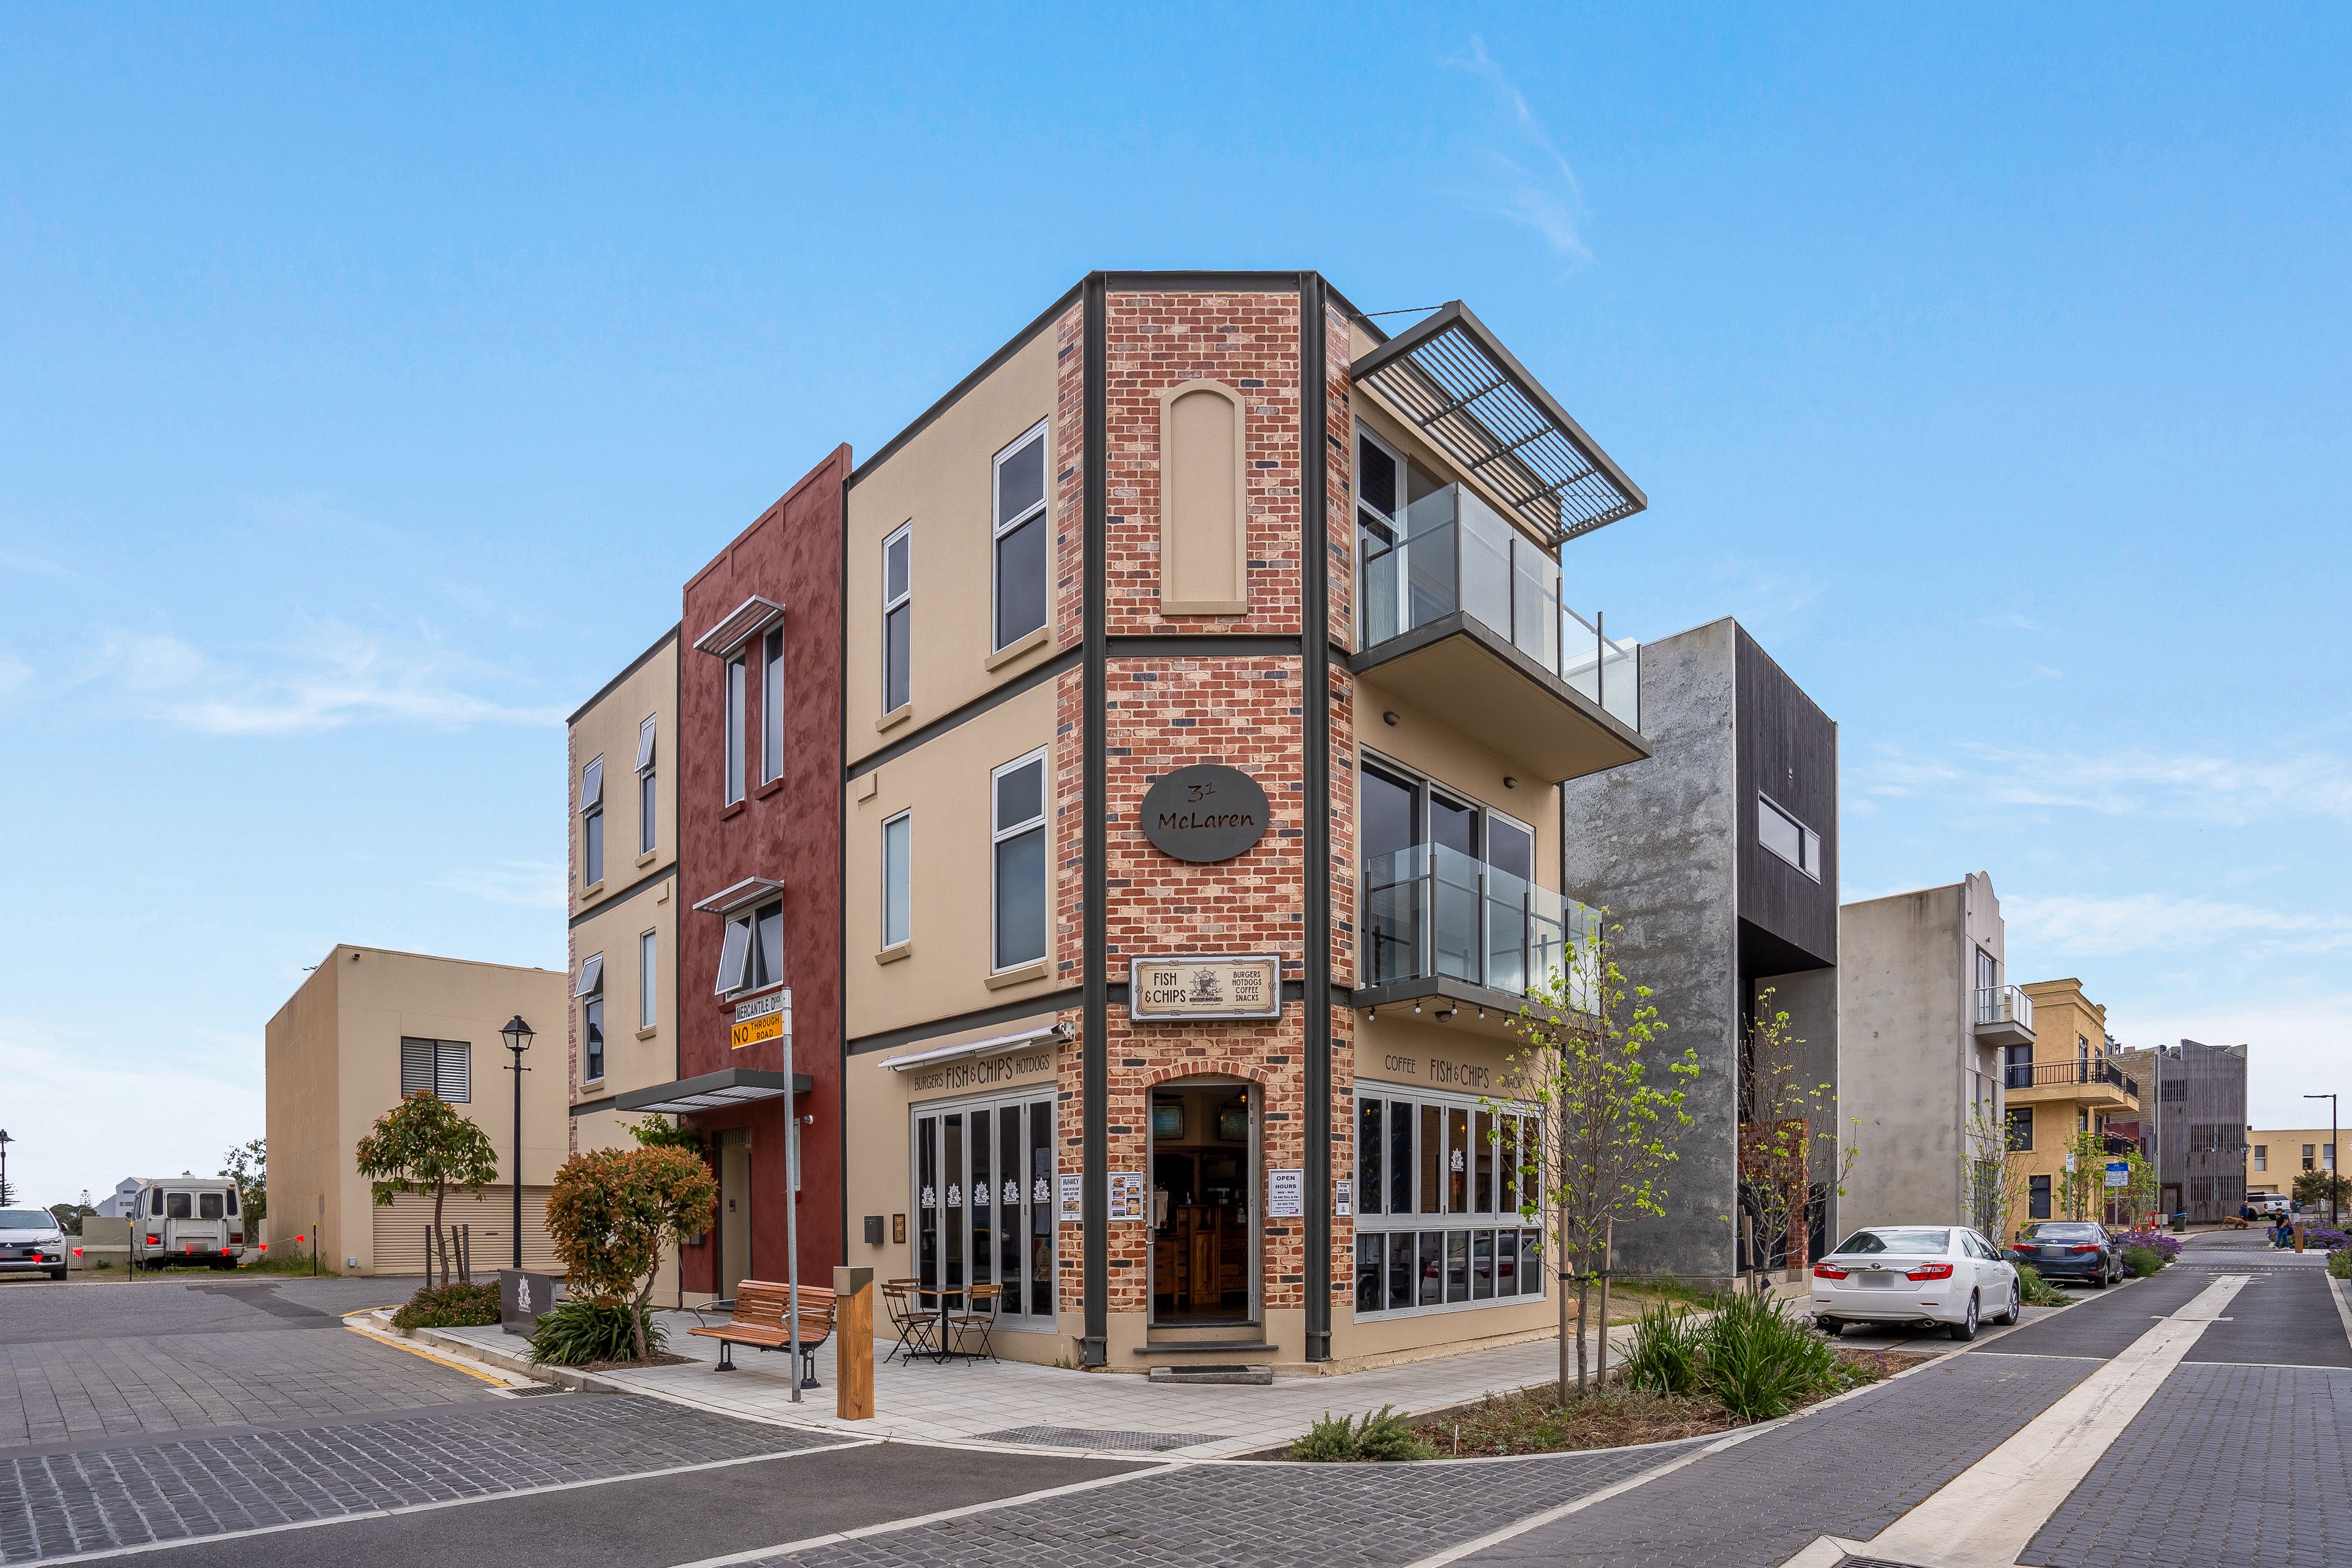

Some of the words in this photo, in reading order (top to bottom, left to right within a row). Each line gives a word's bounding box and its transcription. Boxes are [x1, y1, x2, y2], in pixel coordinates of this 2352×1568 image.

[1187, 782, 1216, 804] 31
[1157, 812, 1255, 831] McLaren
[1153, 971, 1177, 987] FISH
[1232, 978, 1262, 987] HOTDOGS
[1153, 989, 1186, 1004] CHIPS
[1235, 993, 1259, 1002] SNACKS
[737, 998, 769, 1020] MERCANTILE
[734, 1026, 748, 1045] NO
[751, 1015, 780, 1031] THROUGH
[756, 1029, 774, 1041] ROAD
[914, 1072, 944, 1091] BURGERS
[946, 1064, 969, 1090] FISH
[970, 1067, 976, 1083] &
[977, 1057, 1014, 1084] CHIPS
[1016, 1054, 1050, 1075] HOTDOGS
[1385, 1054, 1416, 1074] COFFEE
[1430, 1058, 1452, 1084] FISH
[1453, 1066, 1459, 1082] &
[1460, 1063, 1490, 1089] CHIPS
